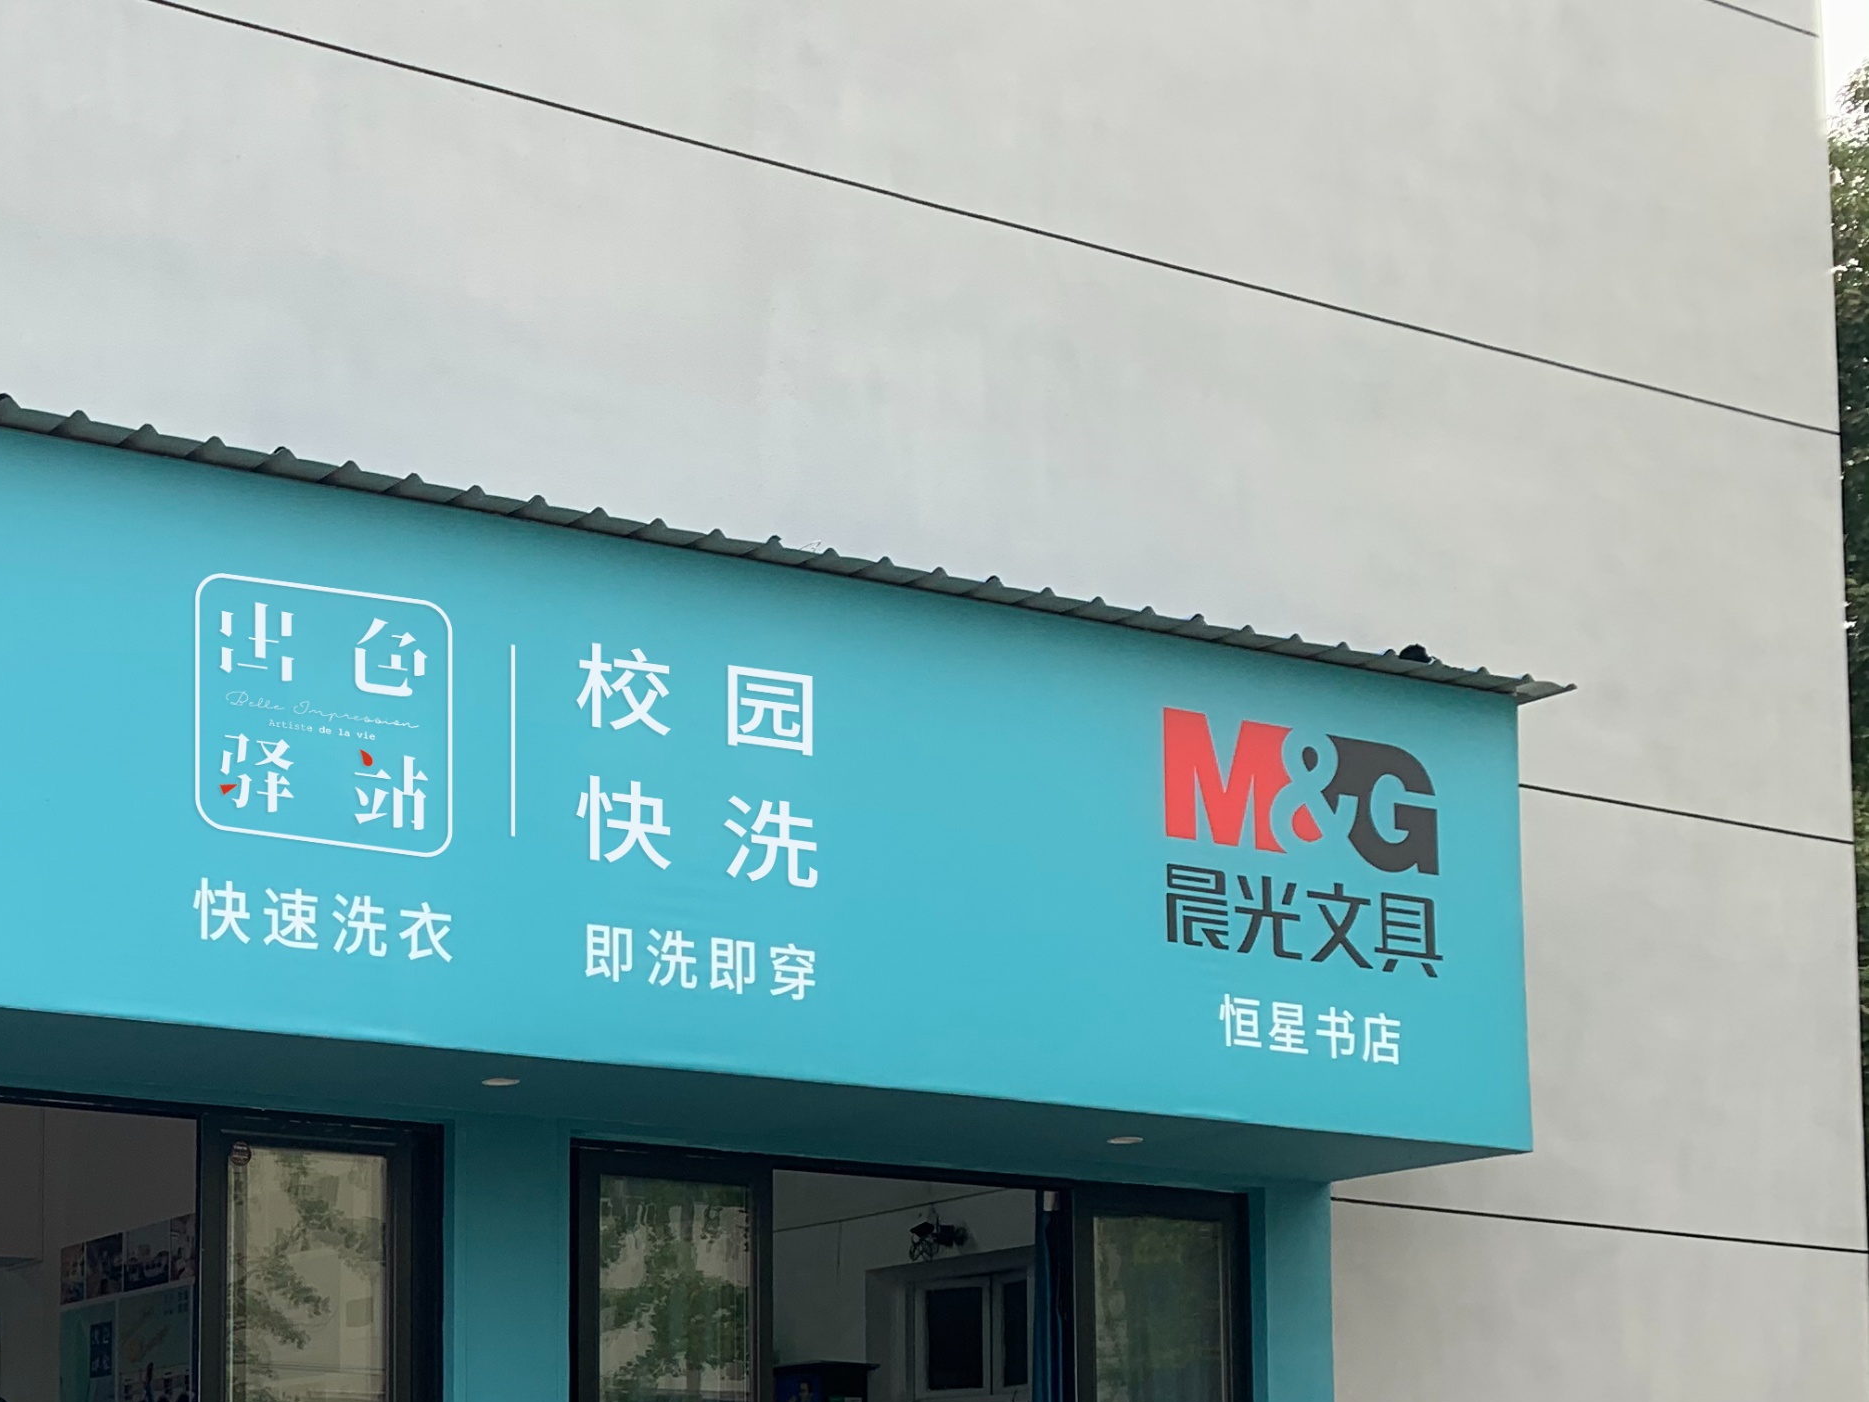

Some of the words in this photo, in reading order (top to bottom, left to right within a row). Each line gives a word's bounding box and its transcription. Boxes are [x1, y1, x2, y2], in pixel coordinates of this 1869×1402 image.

[218, 602, 428, 698] 出色
[225, 690, 286, 711] Belle
[268, 718, 313, 733] Artiste
[318, 724, 332, 736] de
[338, 727, 351, 739] la
[356, 730, 376, 742] vie
[576, 642, 814, 757] 校园
[219, 733, 429, 831] 驿站
[1164, 707, 1440, 876] M&G
[576, 774, 819, 889] 快洗
[193, 876, 454, 964] 快速洗衣
[585, 923, 817, 1001] 即洗即穿
[1165, 863, 1444, 978] 晨光文具
[1219, 993, 1402, 1066] 恒星书店
